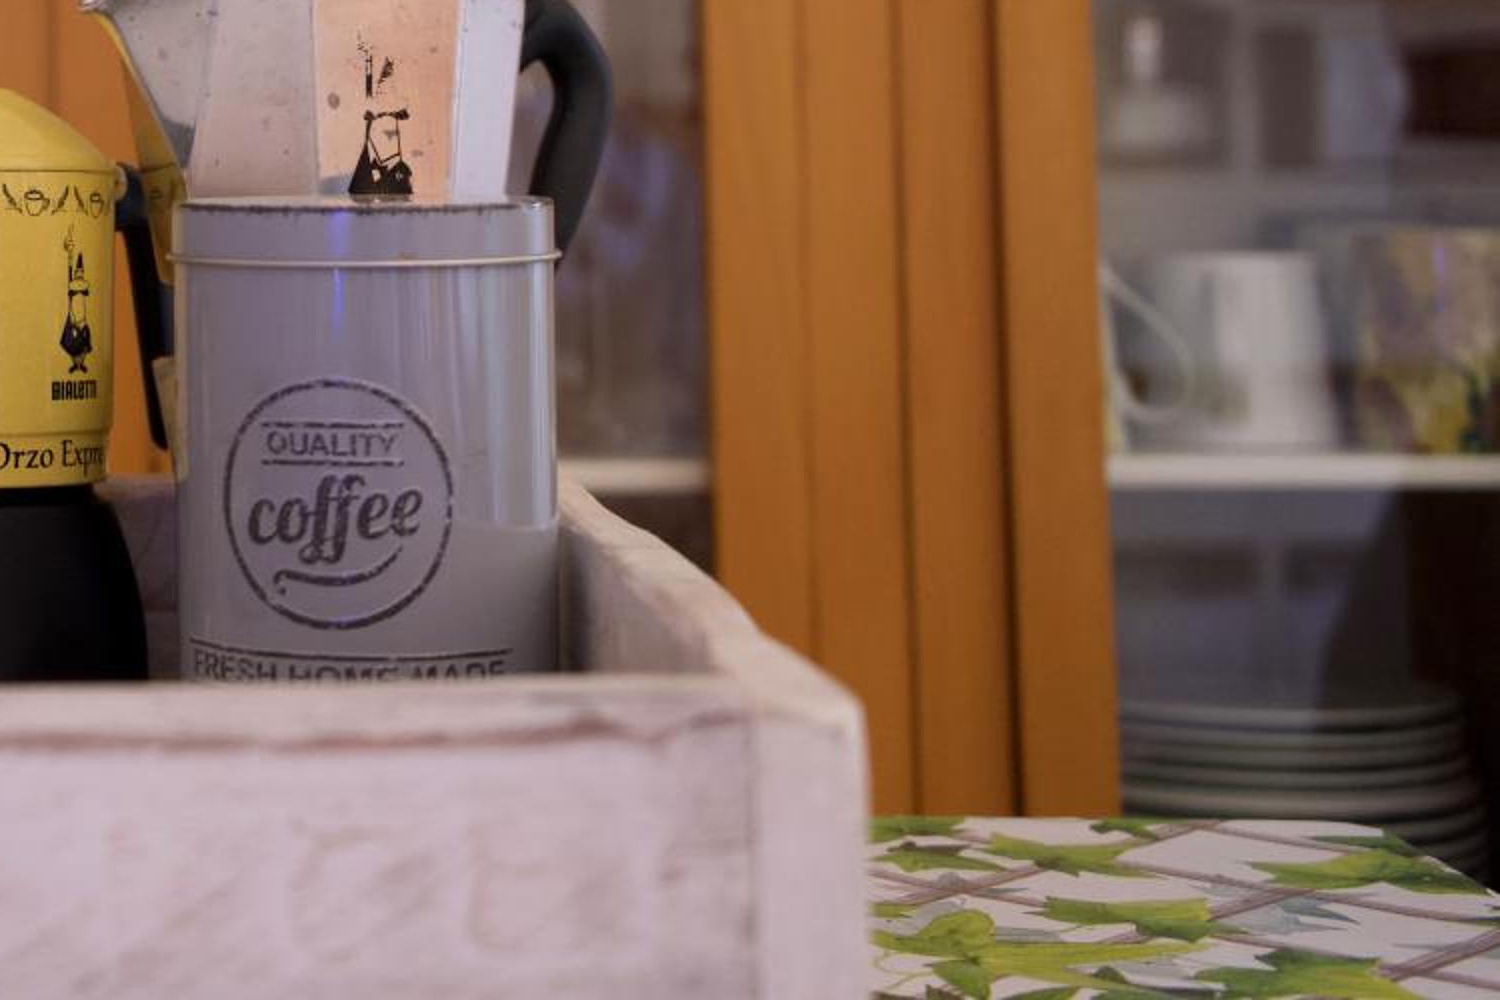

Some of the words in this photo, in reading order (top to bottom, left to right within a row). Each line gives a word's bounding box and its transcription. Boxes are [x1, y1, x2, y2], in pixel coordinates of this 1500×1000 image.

[267, 431, 396, 456] QUALITY
[248, 474, 423, 564] coffee
[195, 650, 277, 680] FRESH
